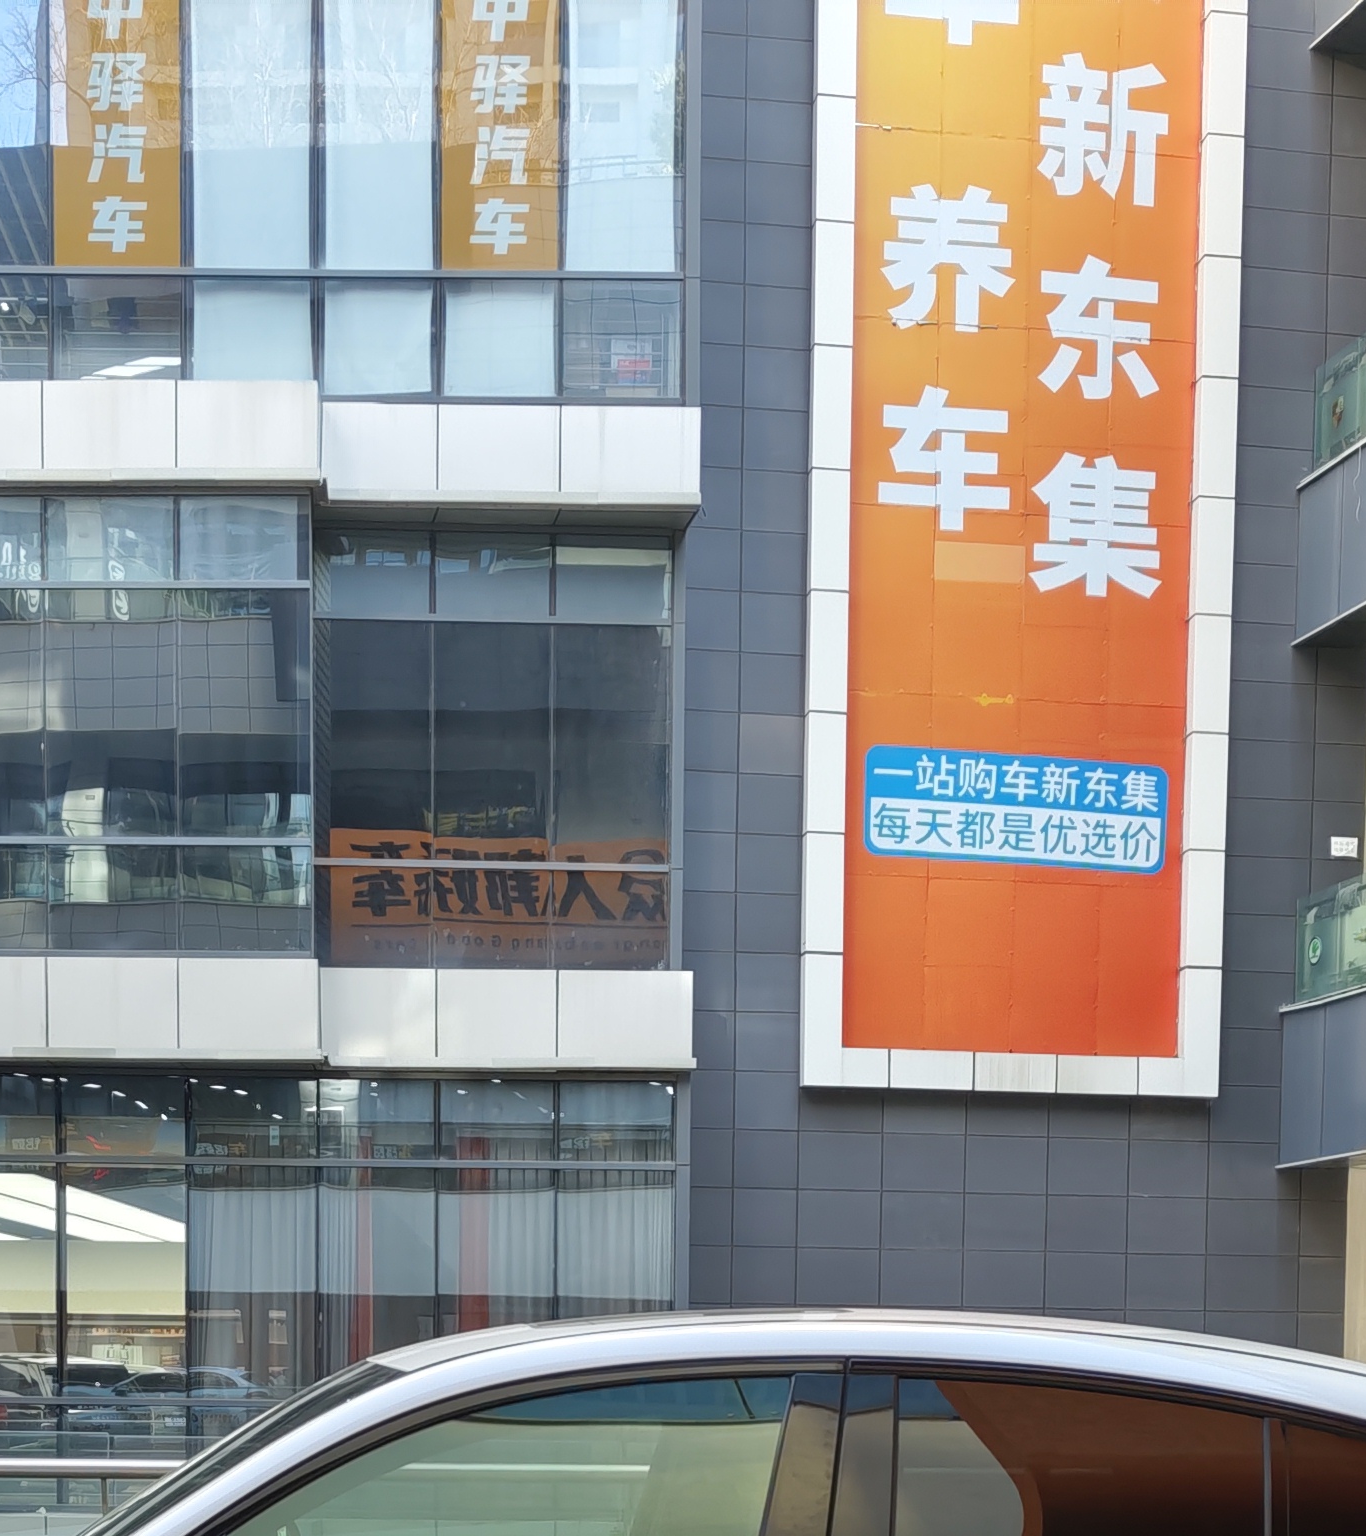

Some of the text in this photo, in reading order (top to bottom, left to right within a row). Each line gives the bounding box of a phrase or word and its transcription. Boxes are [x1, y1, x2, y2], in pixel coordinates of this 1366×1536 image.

[1030, 52, 1170, 599] 新东集
[872, 754, 1160, 814] 一站购车新东集
[871, 803, 1158, 863] 每天都是优选价
